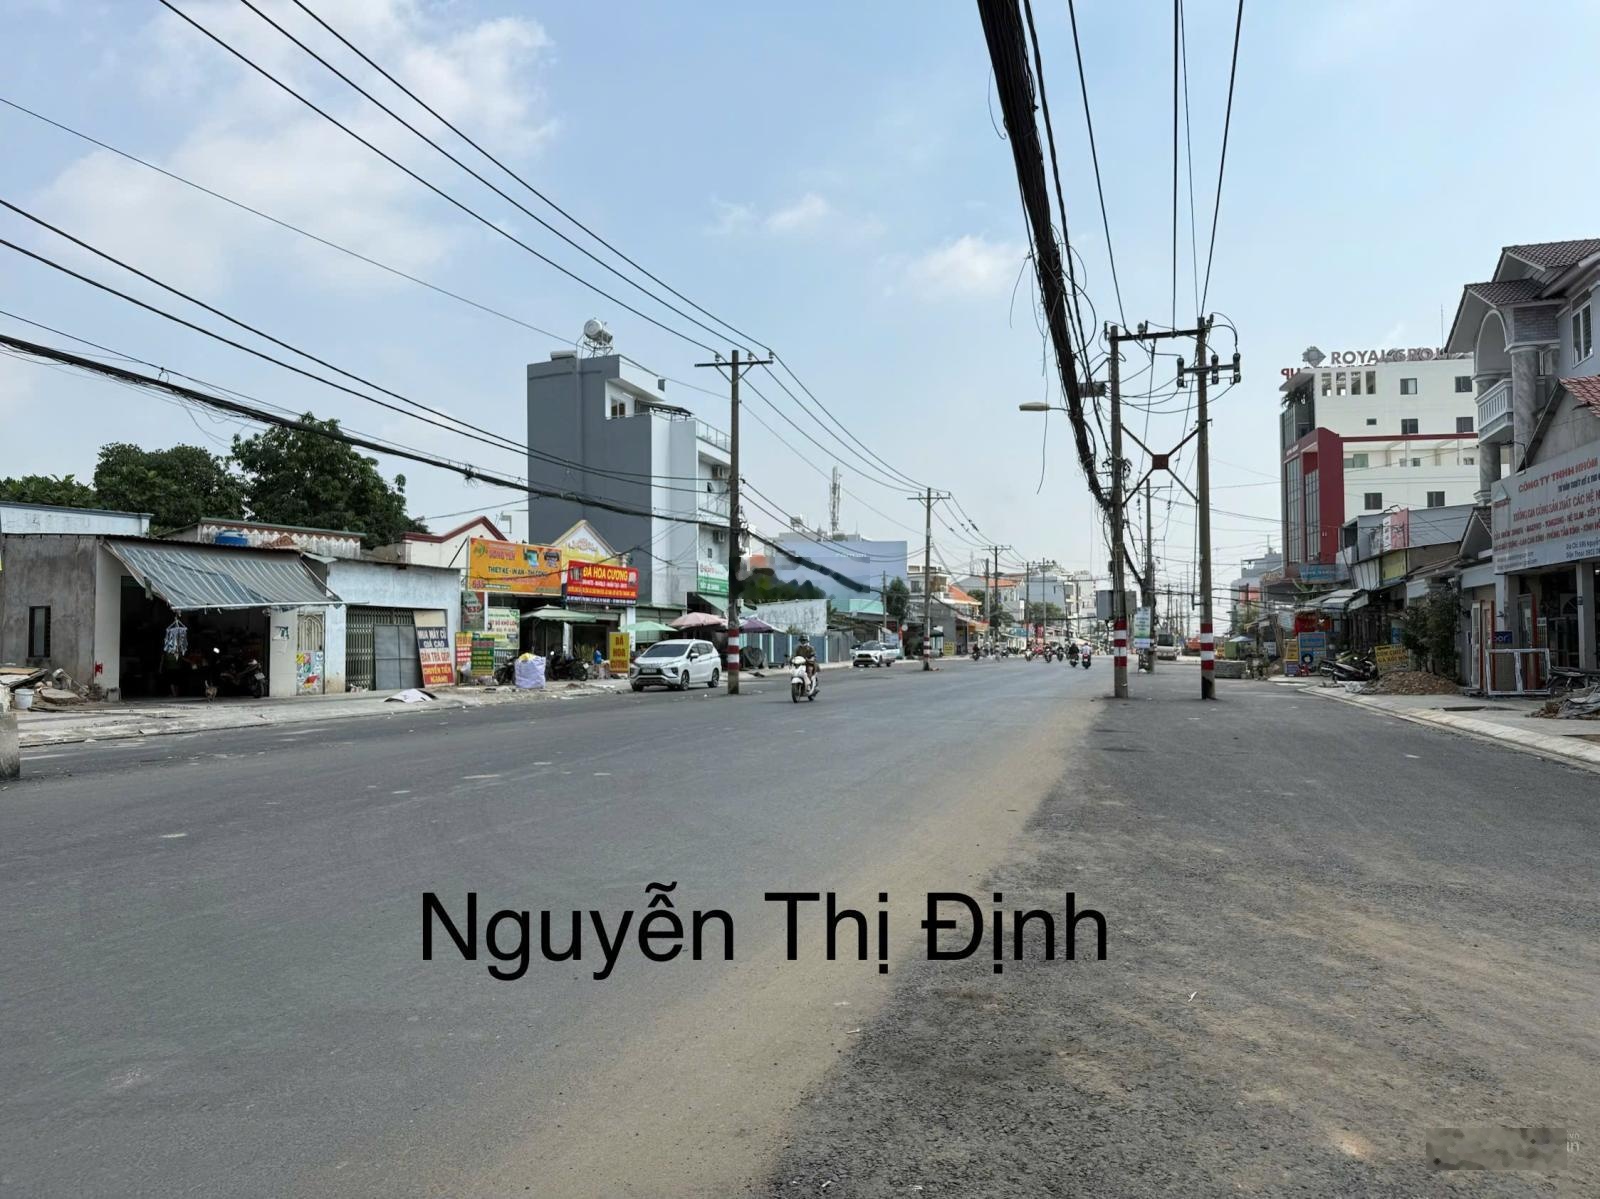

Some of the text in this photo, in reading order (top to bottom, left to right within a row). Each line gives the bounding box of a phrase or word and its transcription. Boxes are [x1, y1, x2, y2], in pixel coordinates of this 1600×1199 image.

[1331, 350, 1385, 364] ROYAL
[583, 565, 593, 577] ĐÁ
[593, 567, 606, 580] HOA
